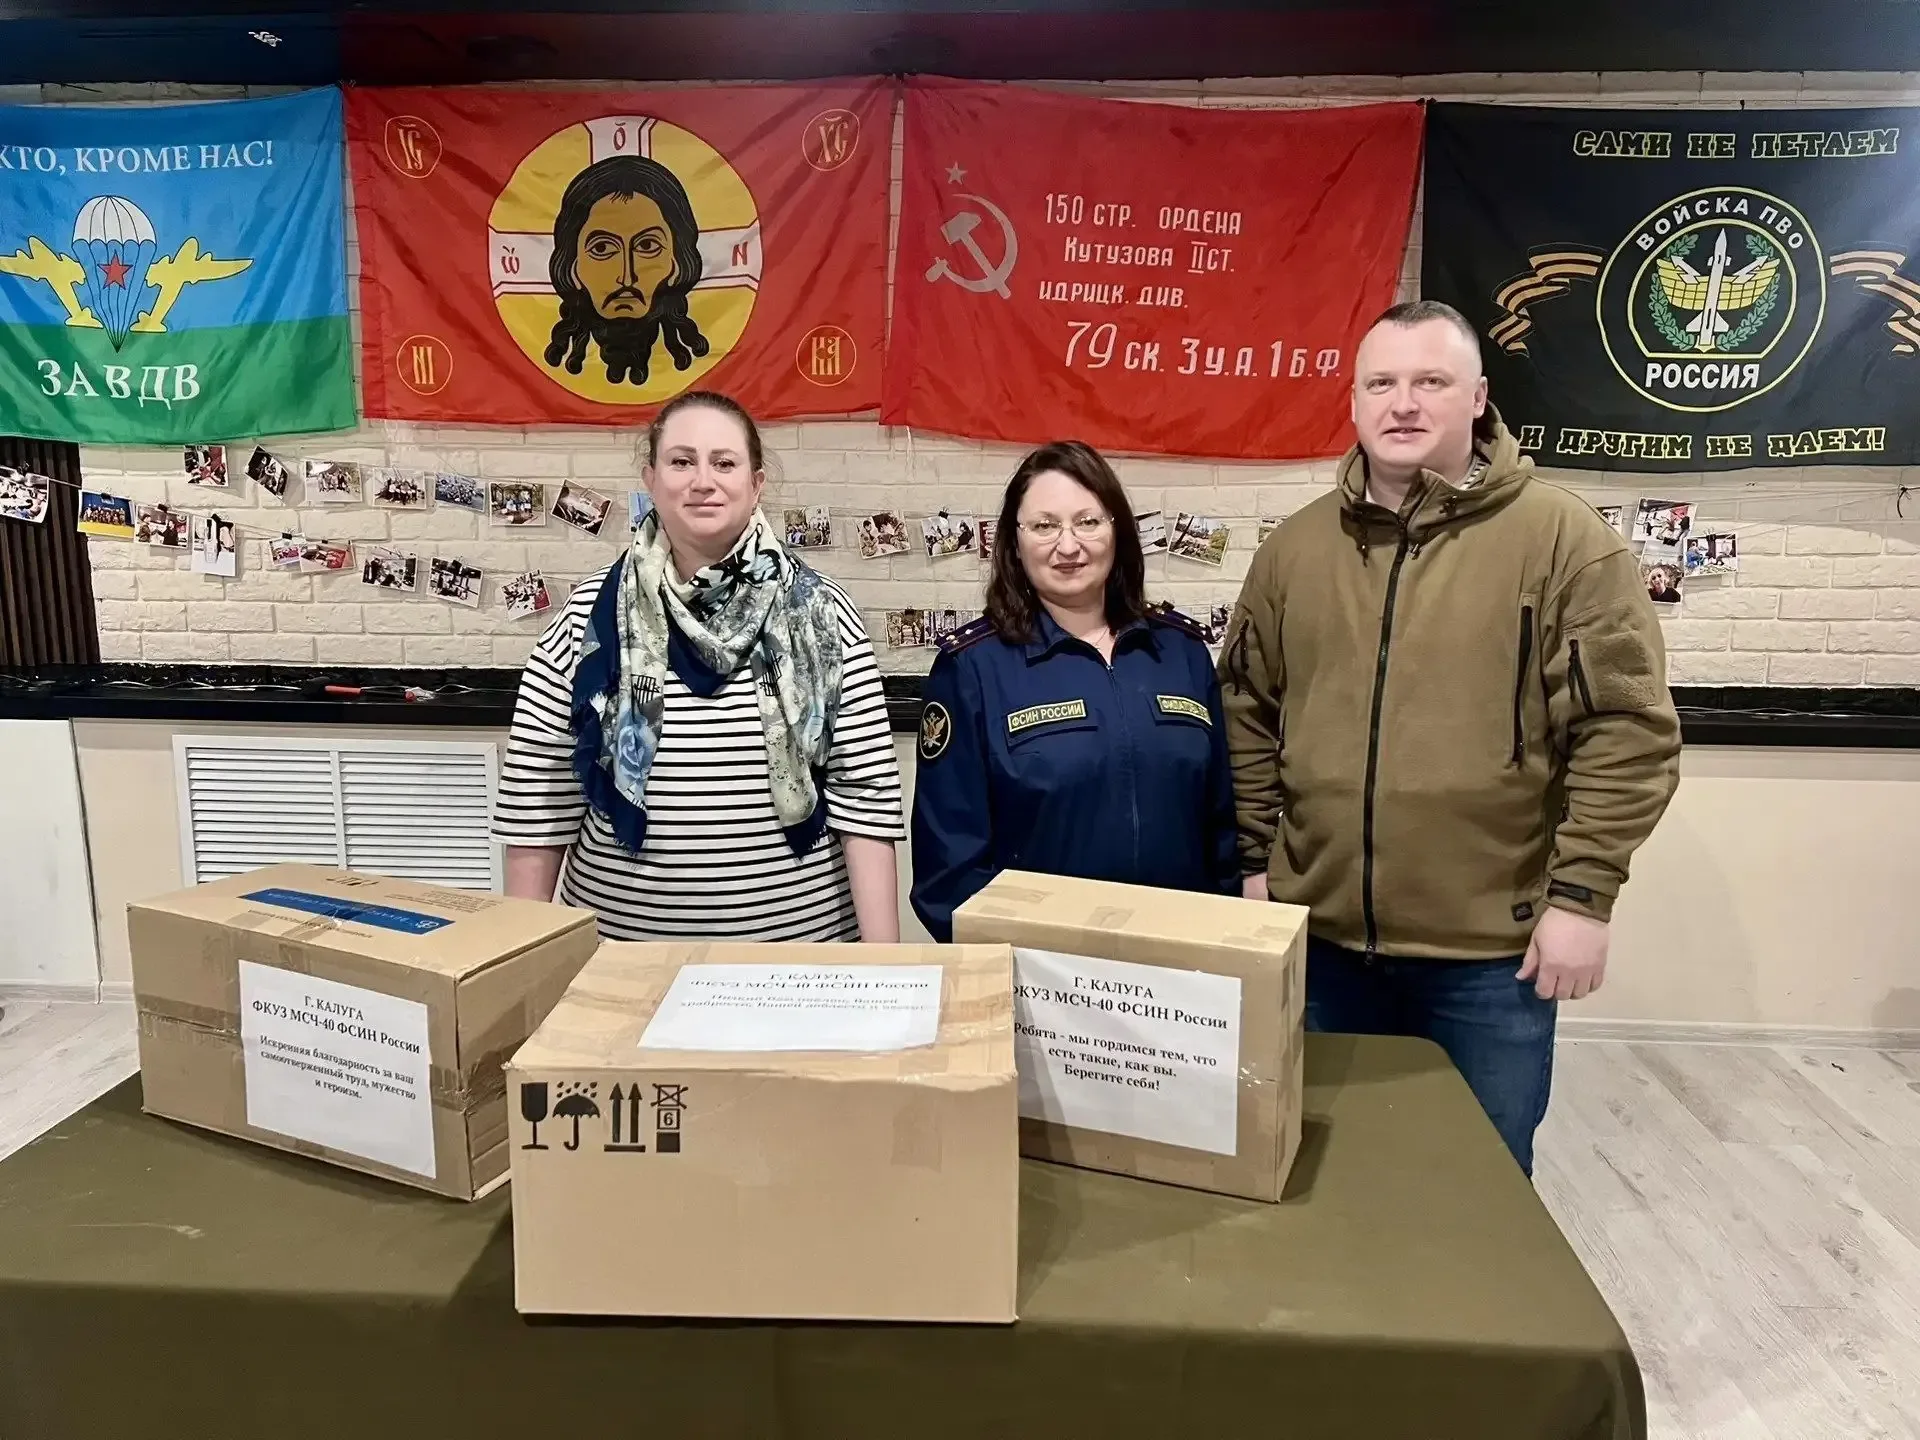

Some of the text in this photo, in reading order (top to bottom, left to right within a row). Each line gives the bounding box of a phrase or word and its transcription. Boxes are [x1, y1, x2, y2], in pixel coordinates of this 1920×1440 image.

[74, 145, 191, 174] КРОМЕ
[199, 141, 274, 169] НАС!
[1573, 130, 1671, 158] САМИ
[1687, 133, 1736, 159] НЕ
[1045, 193, 1242, 236] 150 СТР. ОРДЕНА
[1635, 196, 1804, 251] ВОЙСКА ПВО
[1136, 285, 1189, 308] ДИВ.
[1065, 321, 1119, 369] 79
[37, 359, 200, 410] ЗА ВДВ
[1645, 362, 1760, 389] РОССИЯ
[1519, 425, 1886, 459] И ДРУГИМ НЕ ДАЕМ!
[1012, 703, 1081, 727] ФСИН РОССИИ
[1074, 976, 1154, 999] Г. КАЛУГА
[304, 995, 364, 1021] Г. КАЛУГА
[1054, 990, 1113, 1012] МСЧ-40
[1117, 1001, 1169, 1021] ФСИН
[1174, 1009, 1228, 1030] России
[252, 999, 420, 1053] ФКУЗ МСЧ-40 ФСИН России
[1014, 1022, 1056, 1040] Ребята
[1068, 1034, 1089, 1046] мы
[1093, 1037, 1156, 1056] гордимся
[1159, 1048, 1188, 1064] тем,
[1193, 1055, 1217, 1067] что
[260, 1050, 416, 1100] самоотверженный труд, мужество
[312, 1047, 381, 1075] благодарность
[382, 1068, 392, 1078] за
[394, 1072, 414, 1085] ваш
[1048, 1047, 1177, 1077] есть такие, как вы.
[1064, 1064, 1161, 1091] Берегите себя!
[315, 1079, 362, 1099] и героизм.
